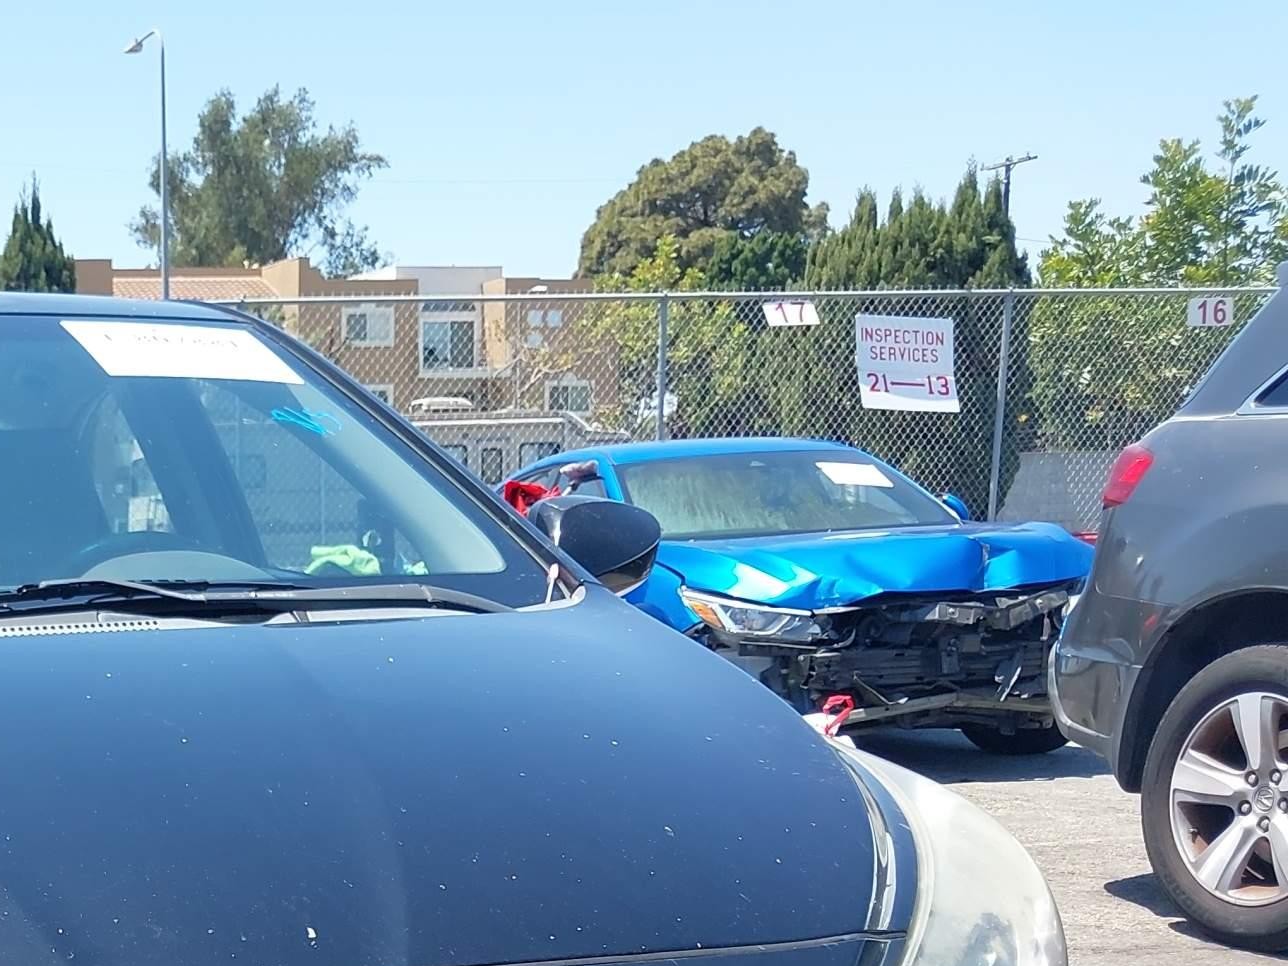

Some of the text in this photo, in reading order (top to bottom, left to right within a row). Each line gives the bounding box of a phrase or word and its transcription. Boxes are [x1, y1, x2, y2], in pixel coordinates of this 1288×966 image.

[775, 301, 806, 323] 17
[1197, 299, 1226, 324] 16
[860, 327, 945, 346] INSPECTION
[869, 345, 939, 363] SERVICES
